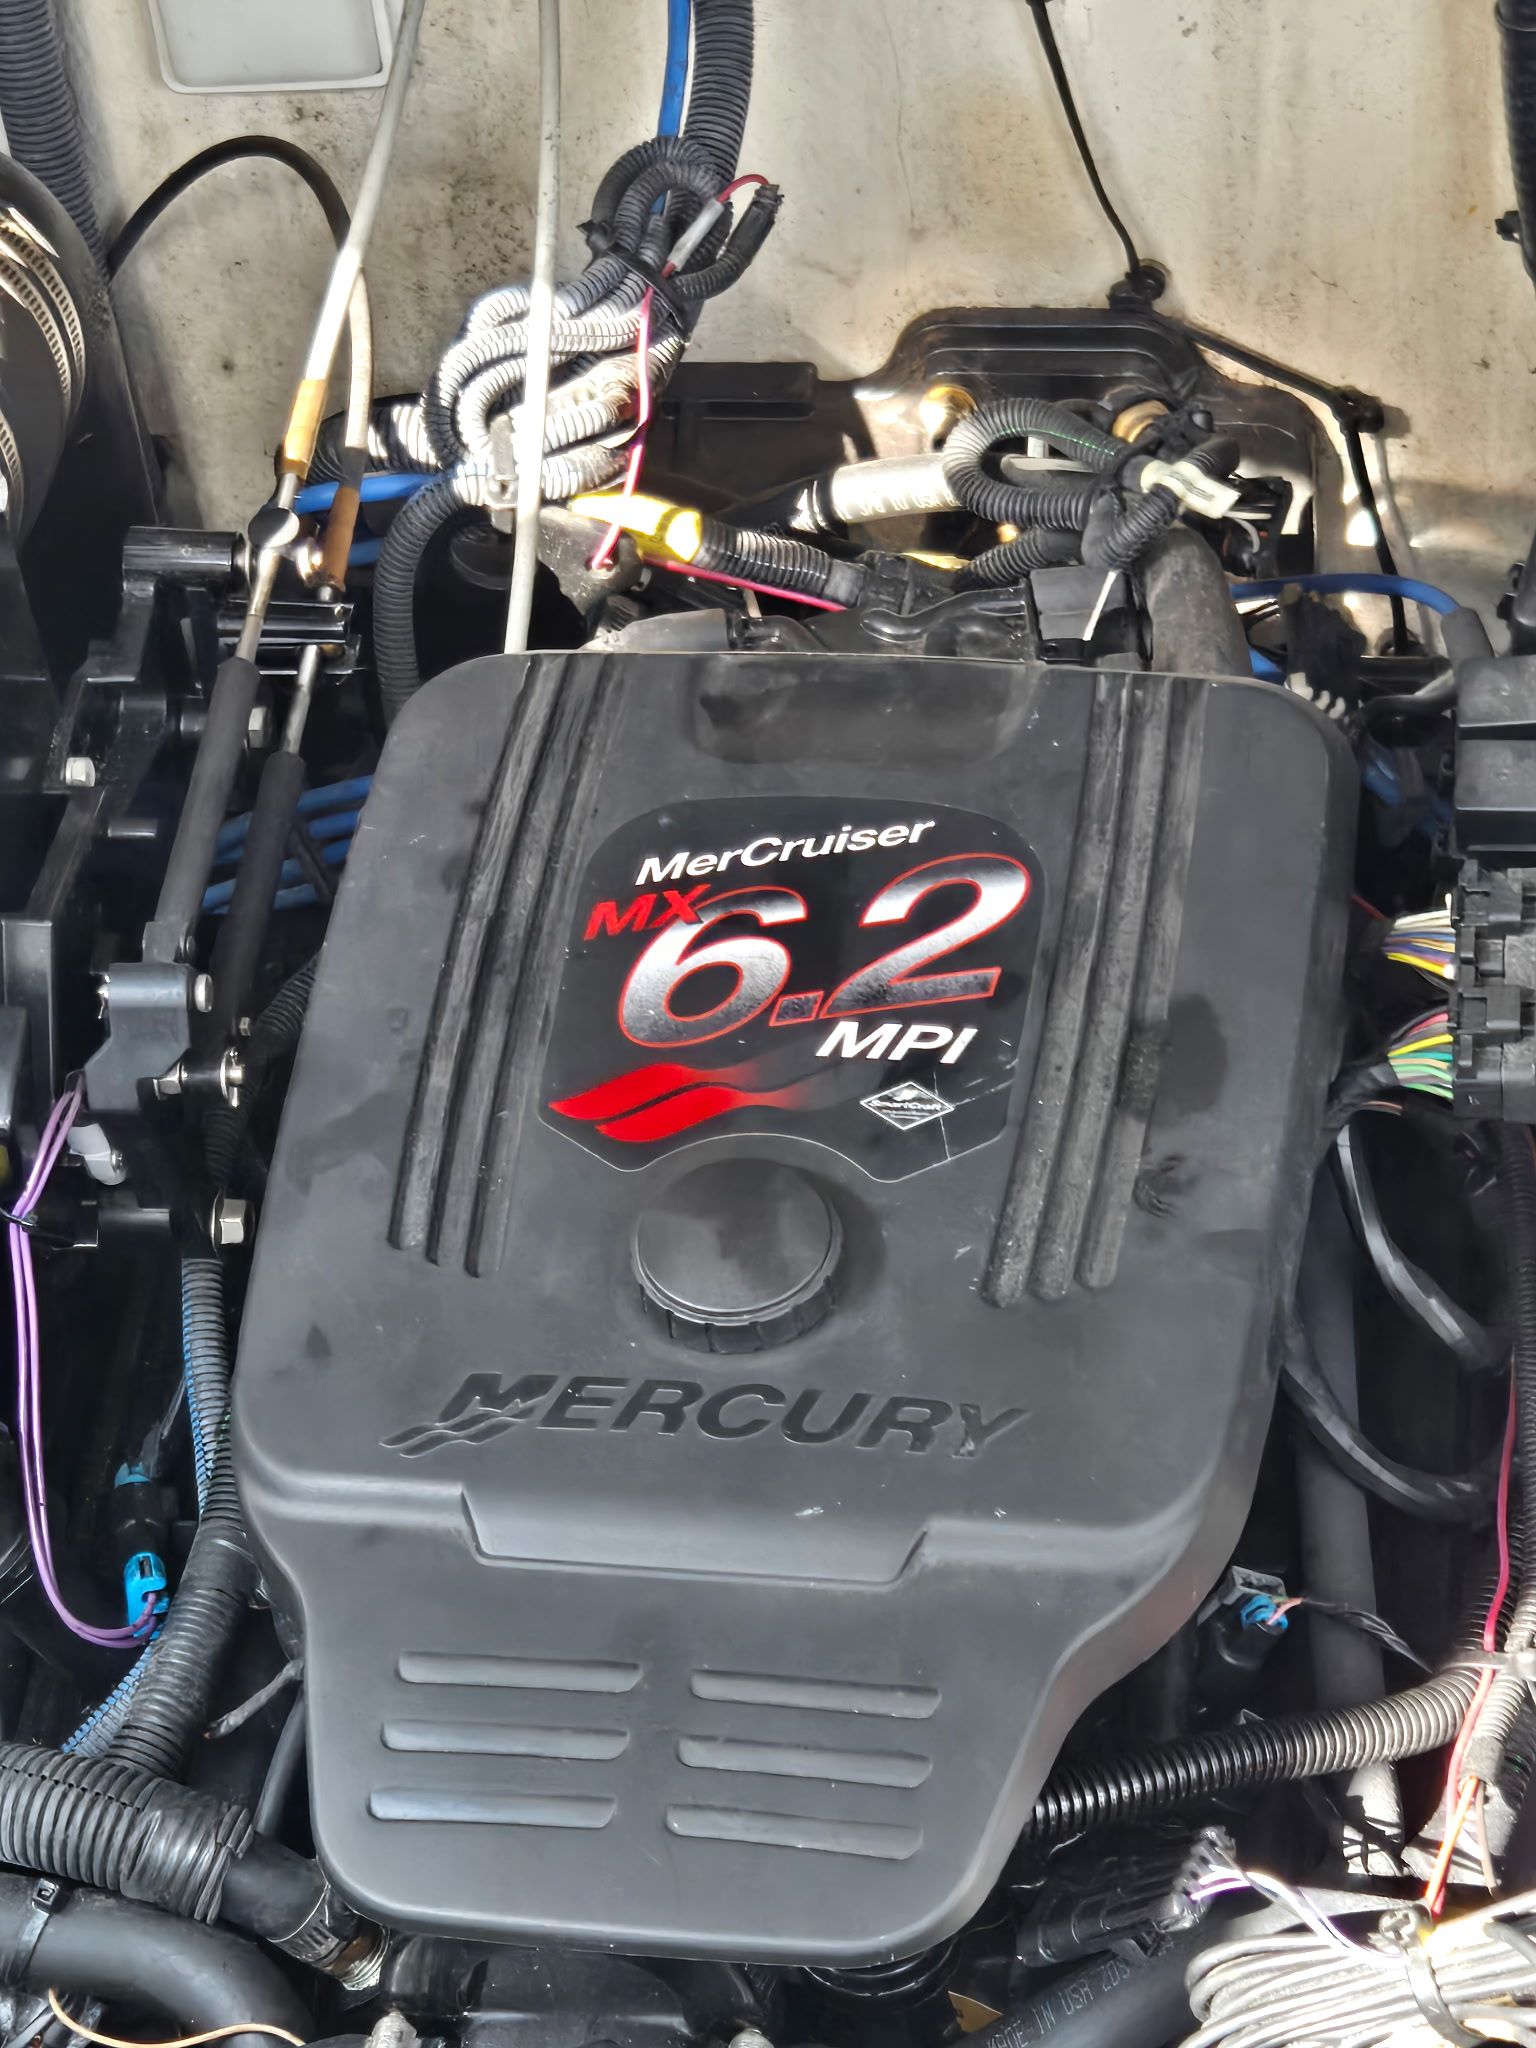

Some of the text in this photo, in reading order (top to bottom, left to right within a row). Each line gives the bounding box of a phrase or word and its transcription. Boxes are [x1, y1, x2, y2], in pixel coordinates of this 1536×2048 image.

[634, 819, 936, 886] MerCruiser
[584, 883, 712, 941] MX
[618, 852, 1031, 1049] 6.2
[815, 1020, 978, 1065] MPI
[380, 1372, 1030, 1458] MERCURY
[1057, 1978, 1094, 2016] USA
